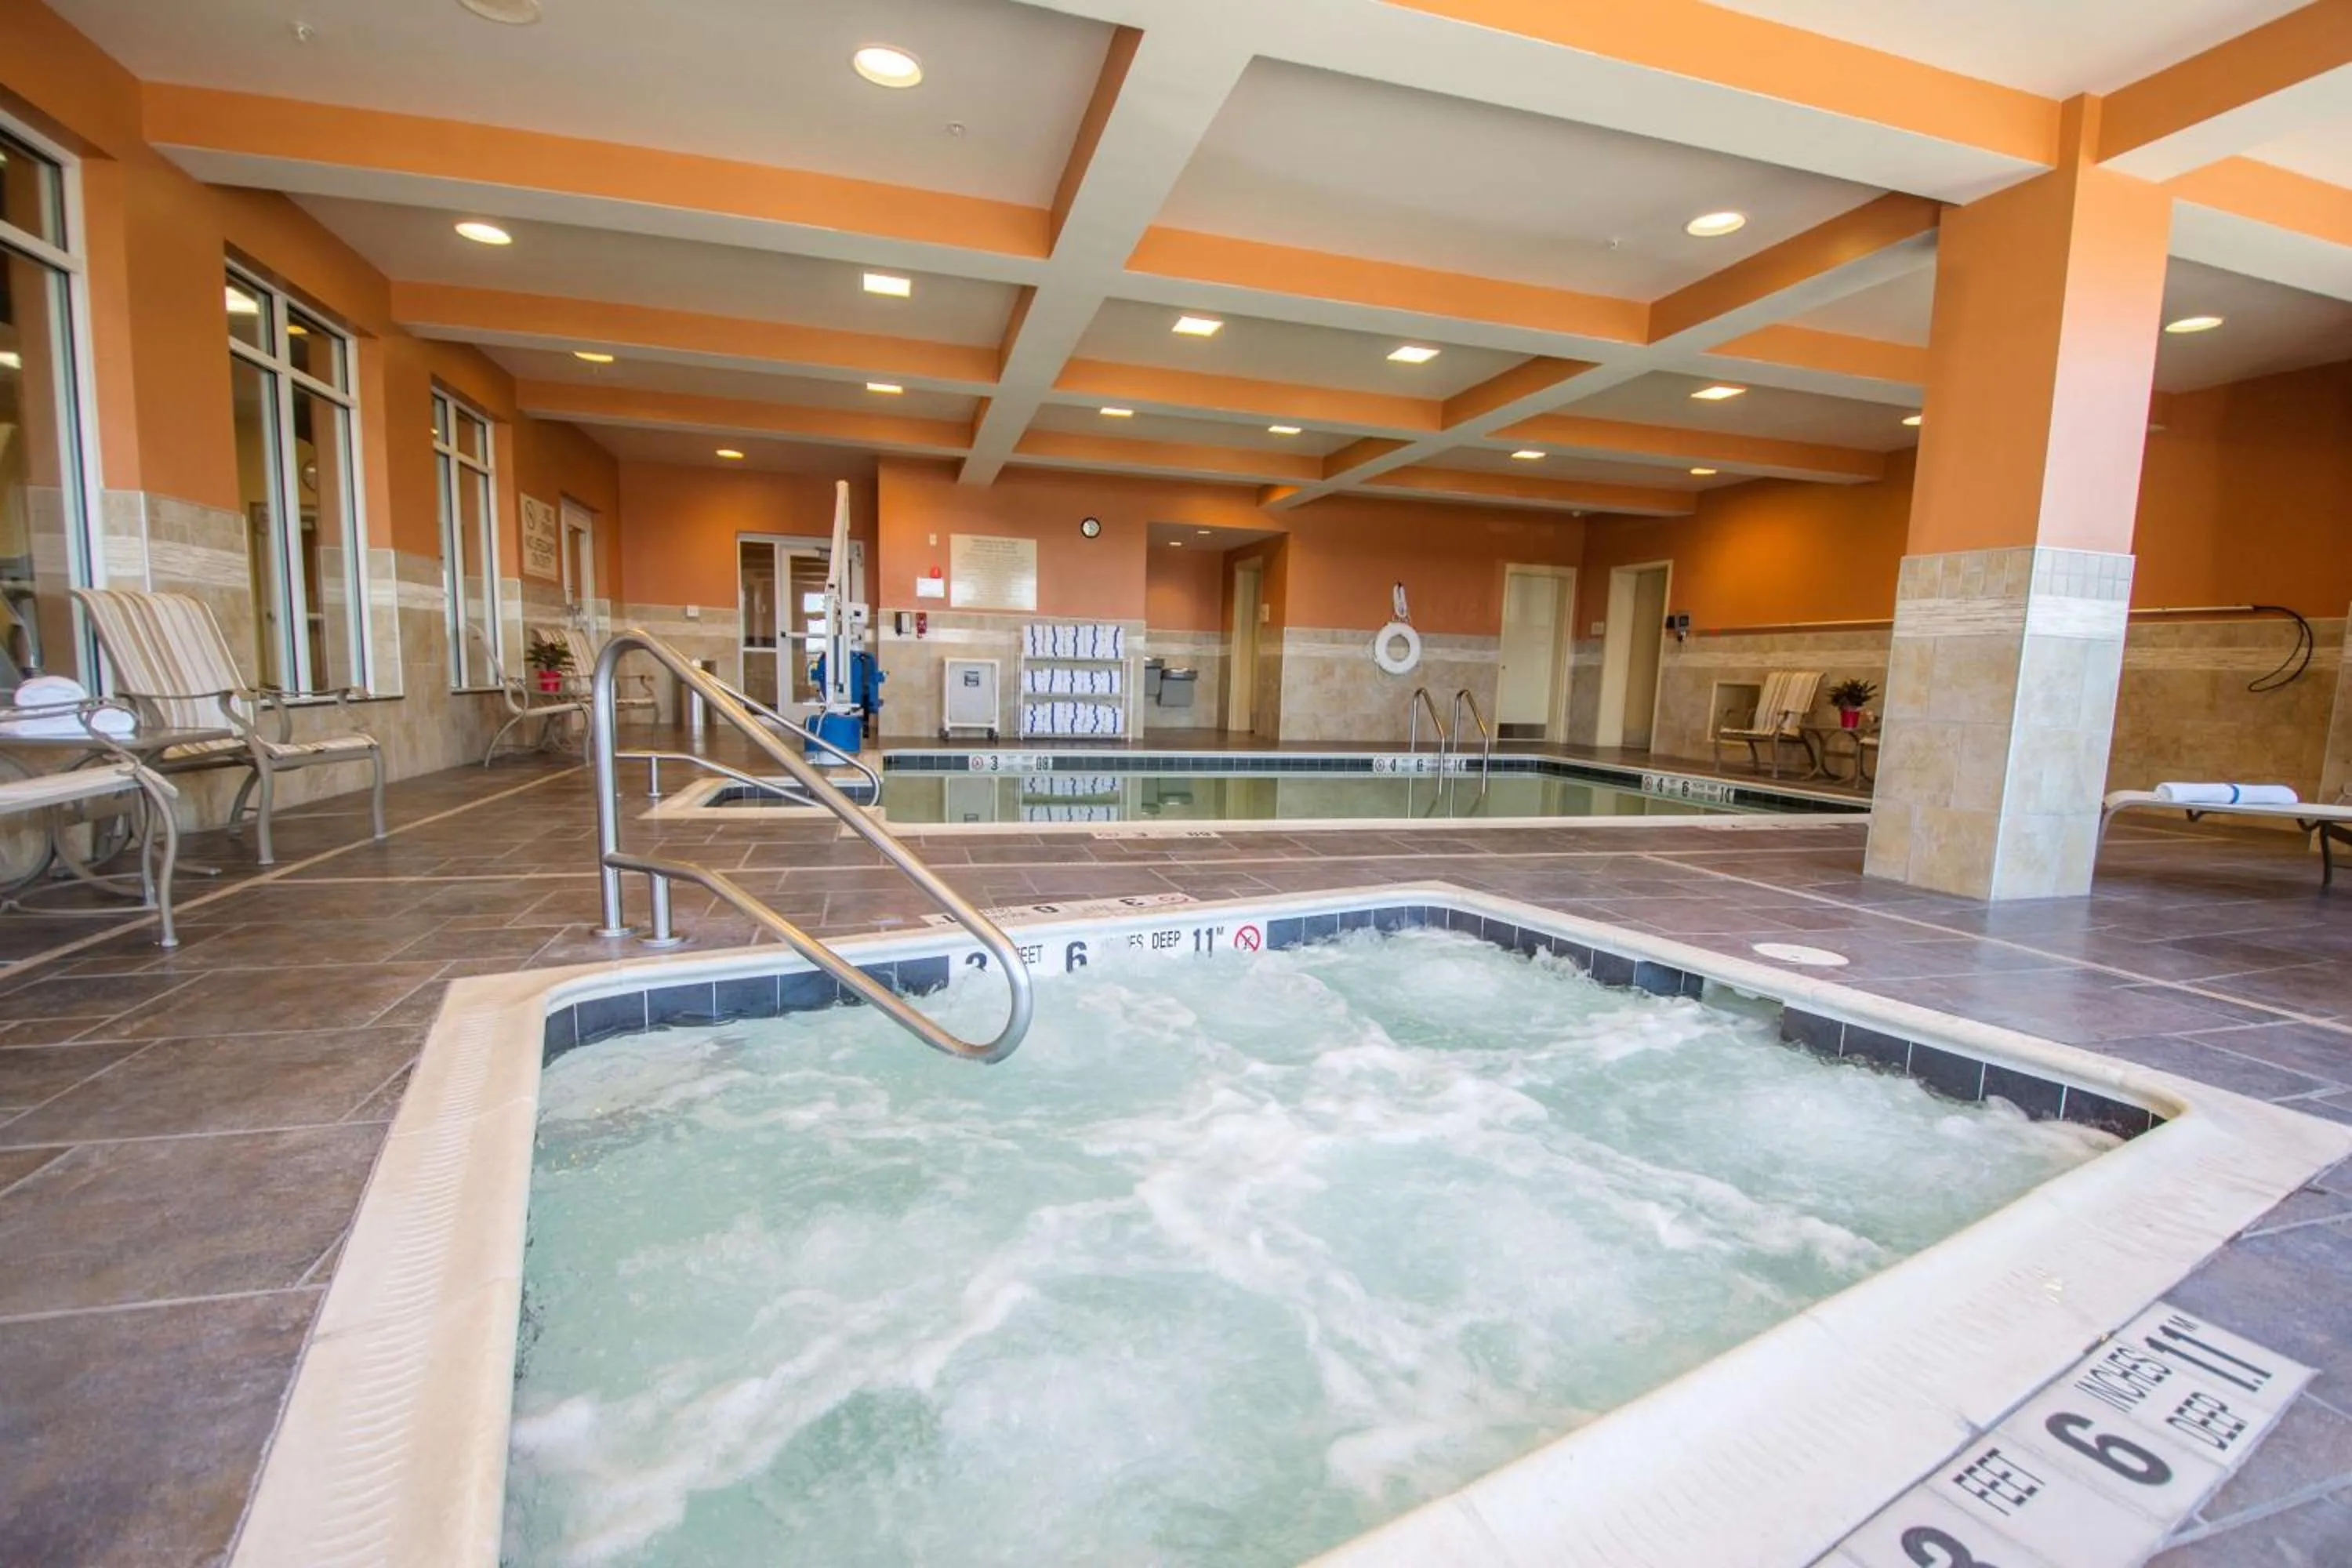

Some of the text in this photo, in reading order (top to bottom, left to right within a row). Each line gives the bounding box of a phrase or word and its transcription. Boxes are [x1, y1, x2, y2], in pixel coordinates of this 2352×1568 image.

[990, 755, 998, 771] 3
[1016, 944, 1044, 965] EET
[1065, 941, 1087, 974] 6
[1152, 930, 1181, 949] DEEP
[2074, 1347, 2172, 1413] INCHES
[2165, 1392, 2249, 1451] DEEP
[1952, 1447, 2045, 1516] FEET
[2045, 1413, 2172, 1486] 6
